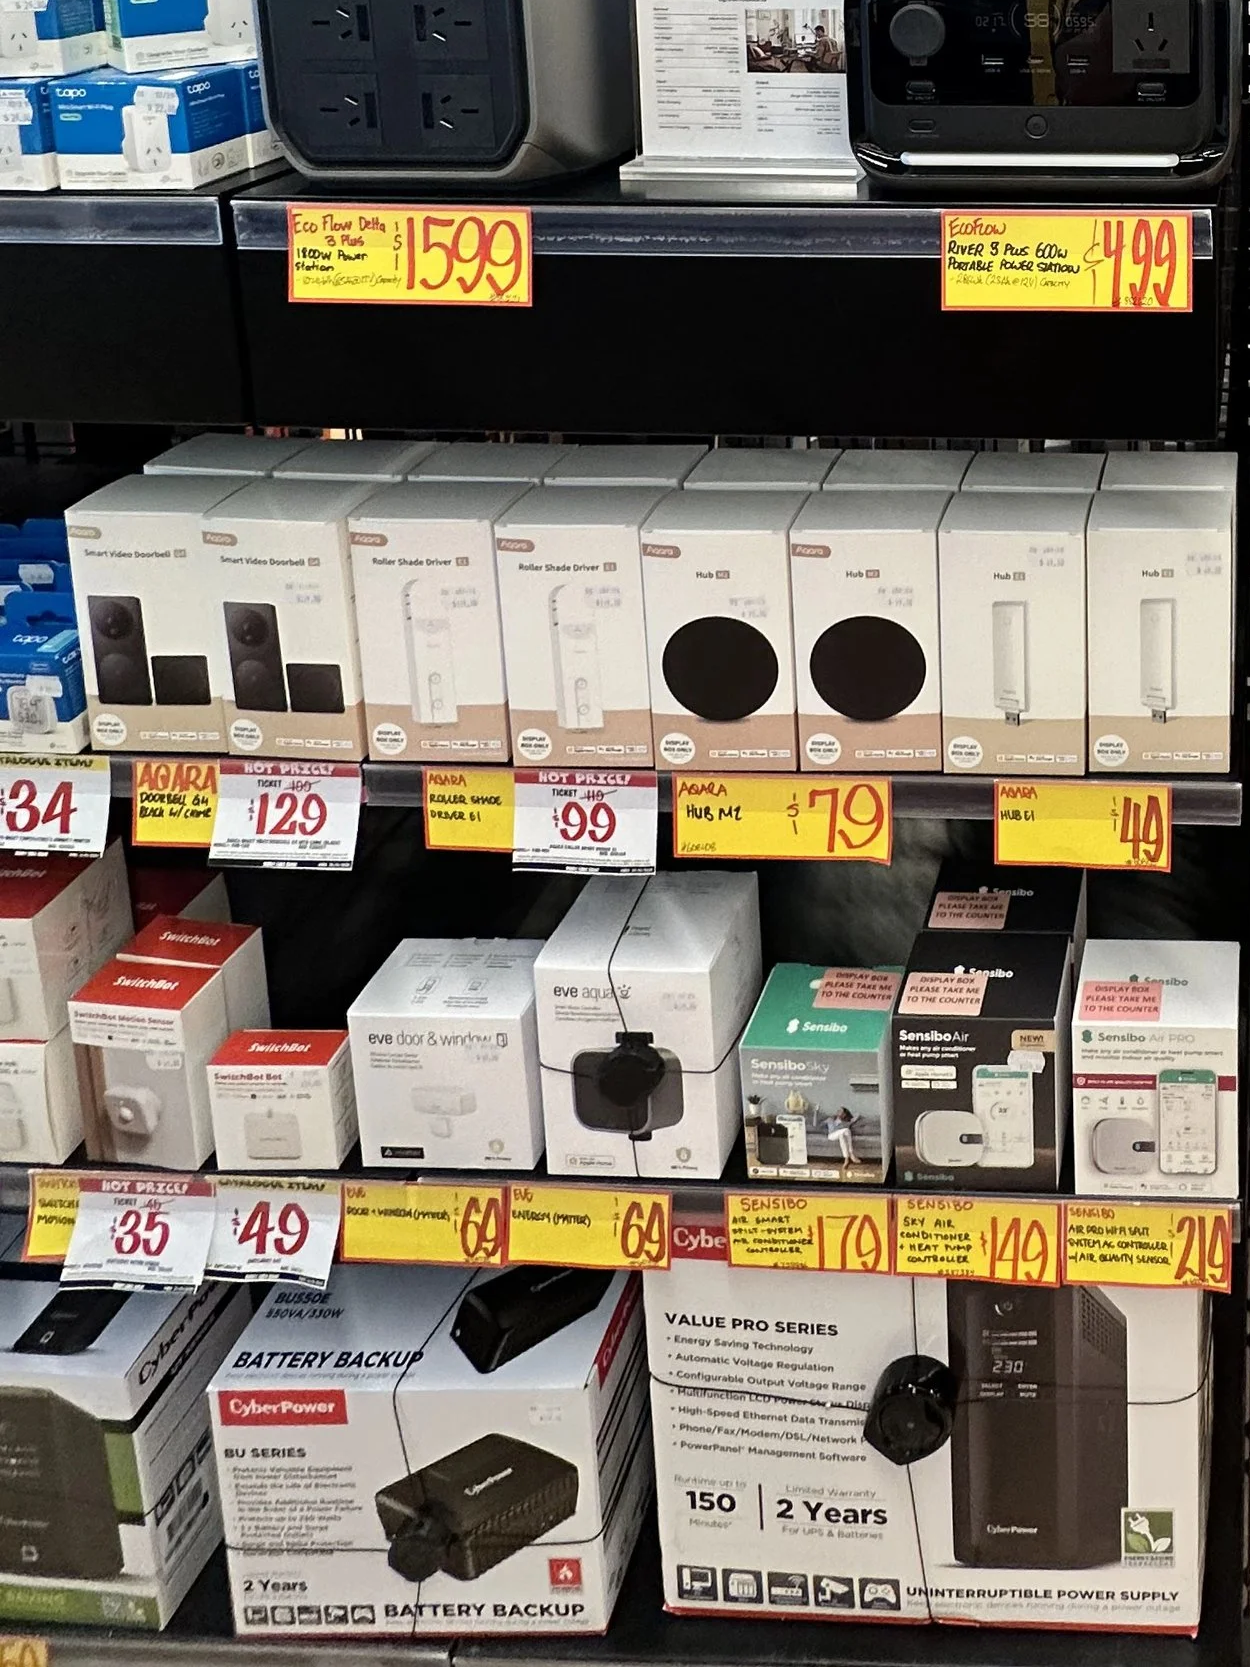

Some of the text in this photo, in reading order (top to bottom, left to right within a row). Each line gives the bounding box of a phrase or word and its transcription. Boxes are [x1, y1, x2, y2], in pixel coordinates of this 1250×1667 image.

[55, 87, 87, 99] tapo
[948, 259, 994, 273] PORTABLE
[1000, 260, 1034, 272] POWER
[372, 557, 396, 566] Roller
[398, 557, 424, 567] Shade
[426, 558, 452, 566] Driver
[518, 563, 543, 572] Roller
[545, 563, 571, 572] Shade
[573, 563, 600, 572] Driver
[993, 572, 1011, 580] Hub
[1142, 569, 1160, 577] Hub
[244, 762, 335, 776] HOT PRICE!
[138, 764, 219, 794] AQARA
[539, 772, 569, 783] HOT
[575, 772, 632, 785] PRICE!
[552, 788, 577, 798] TICKET
[678, 781, 727, 797] AQARA
[687, 805, 714, 821] HUB
[1001, 810, 1022, 821] HUB
[159, 931, 221, 948] SwitchBot
[113, 975, 179, 991] SwitchBot
[920, 976, 953, 984] DISPLAY
[554, 985, 614, 1002] eve aqua
[909, 985, 980, 995] PLEASE TAKE ME
[921, 996, 936, 1004] THE
[938, 996, 981, 1006] COUNTER
[802, 1021, 848, 1033] Sensibo
[368, 1033, 393, 1045] eve
[397, 1031, 425, 1046] door
[427, 1032, 438, 1046] &
[248, 1042, 311, 1054] SwitchBot
[101, 1180, 188, 1195] HOT PRICE!
[740, 1198, 807, 1212] SENSIBO
[907, 1199, 973, 1212] SENSIBO
[903, 1216, 954, 1228] SKY AIR
[665, 1312, 839, 1336] VALUE PRO SERIES
[674, 1335, 814, 1355] Energy Saving Technology
[232, 1351, 424, 1368] BATTERY BACKUP
[675, 1353, 834, 1374] Automatic Voltage Regulation
[992, 1360, 1025, 1375] 230
[676, 1370, 867, 1393] Configurable Output Voltage Range
[229, 1398, 336, 1417] CyberPower
[678, 1405, 816, 1425] High-Speed Ethernet Data
[224, 1447, 307, 1459] BU SERIES
[748, 1446, 867, 1463] Management Software
[685, 1491, 888, 1526] 150 2 Years
[986, 1524, 1038, 1535] CyberPower
[243, 1580, 308, 1592] 2 Years
[906, 1586, 1180, 1602] UNINTERRUPTIBLE POWER SUPPLY
[384, 1603, 586, 1618] BATTERY BACKUP
